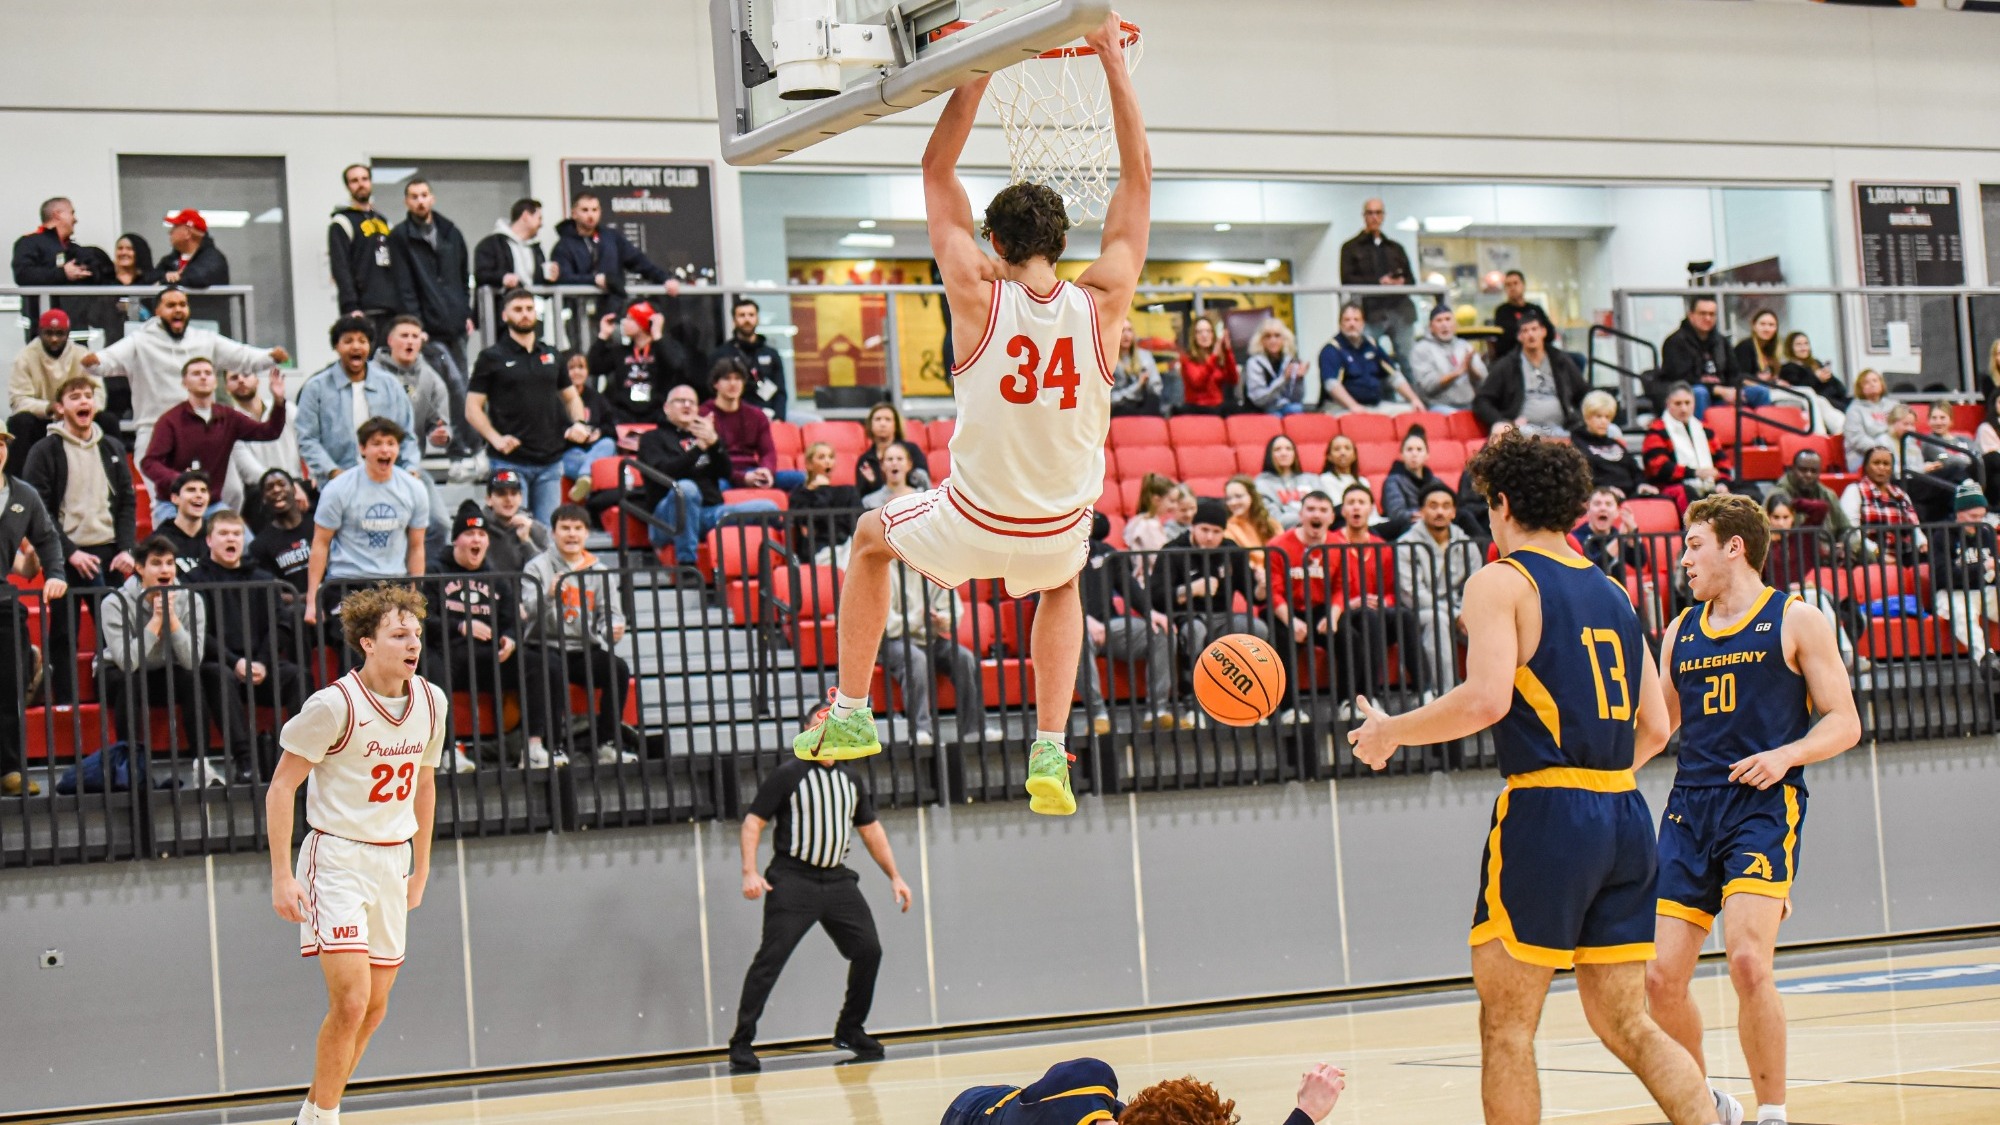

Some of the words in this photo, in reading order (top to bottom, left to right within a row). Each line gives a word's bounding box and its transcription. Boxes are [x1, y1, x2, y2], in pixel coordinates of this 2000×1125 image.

[581, 167, 621, 188] 1,000
[623, 168, 662, 187] POINT
[663, 168, 699, 188] CLUB
[1000, 335, 1080, 410] 34
[1755, 622, 1772, 632] GB
[1210, 647, 1254, 697] Wilson
[1580, 627, 1631, 721] 13
[1679, 651, 1767, 674] ALLEGHENY
[1703, 673, 1737, 715] 20
[363, 738, 423, 758] Presidents
[368, 762, 414, 803] 23
